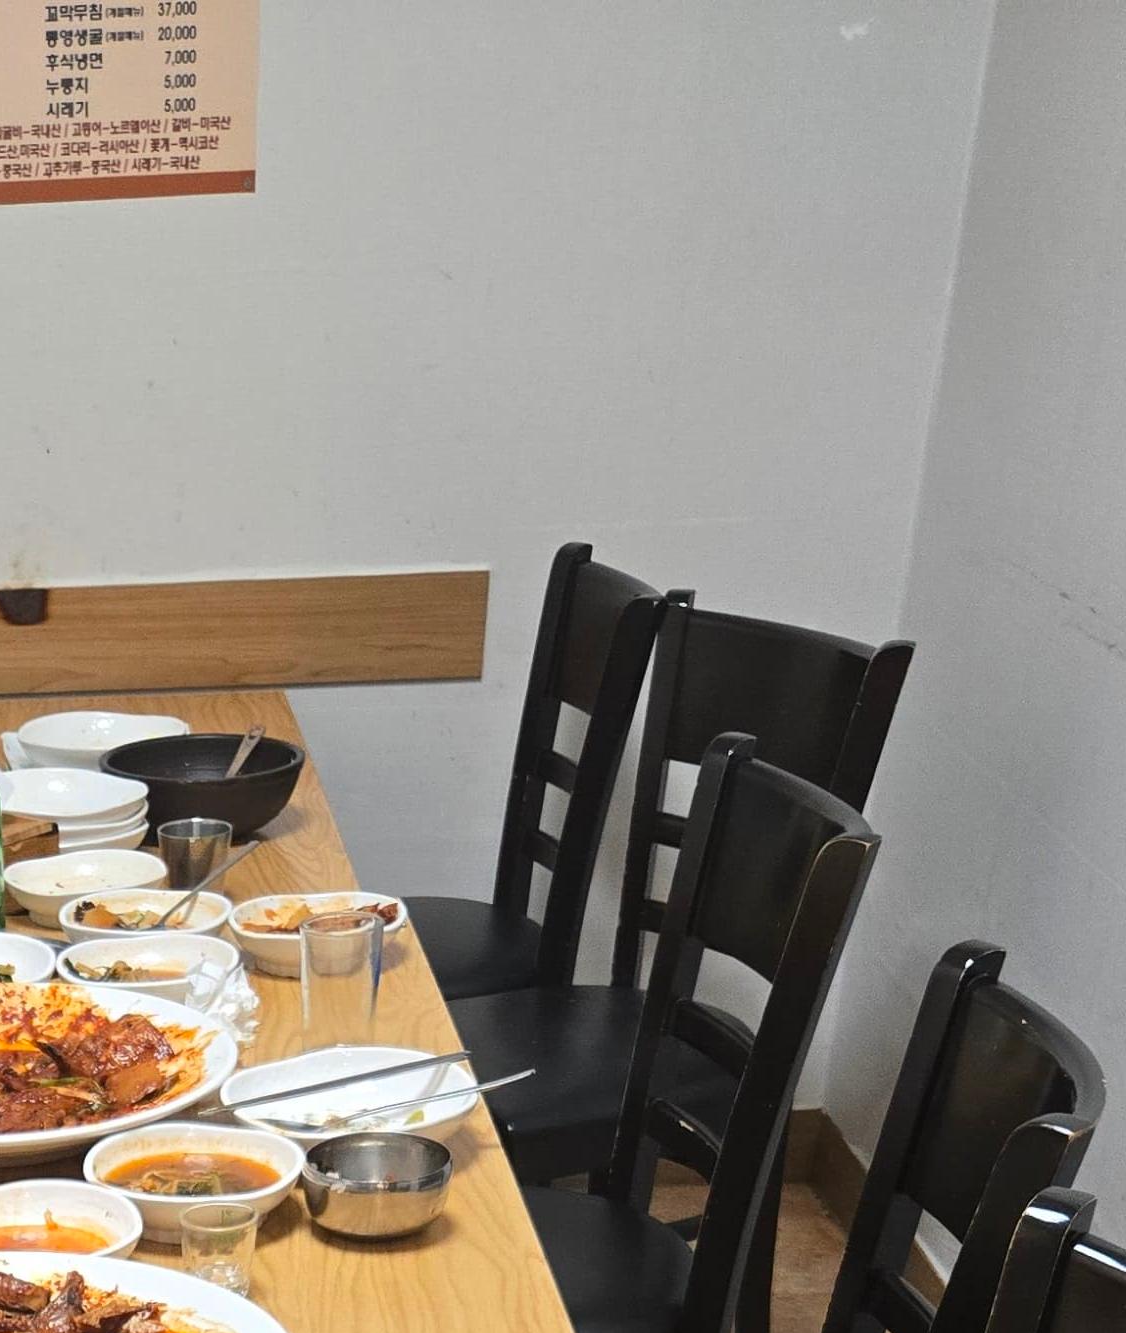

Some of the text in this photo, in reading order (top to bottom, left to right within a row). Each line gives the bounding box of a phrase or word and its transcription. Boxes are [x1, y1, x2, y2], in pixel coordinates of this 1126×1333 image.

[158, 1, 197, 17] 37,000
[45, 28, 103, 48] 통영생굴
[158, 26, 197, 42] 20,000
[45, 50, 196, 71] 후식냉면 7,000
[46, 74, 196, 95] 누룽지 5,000
[164, 98, 196, 114] 5,000
